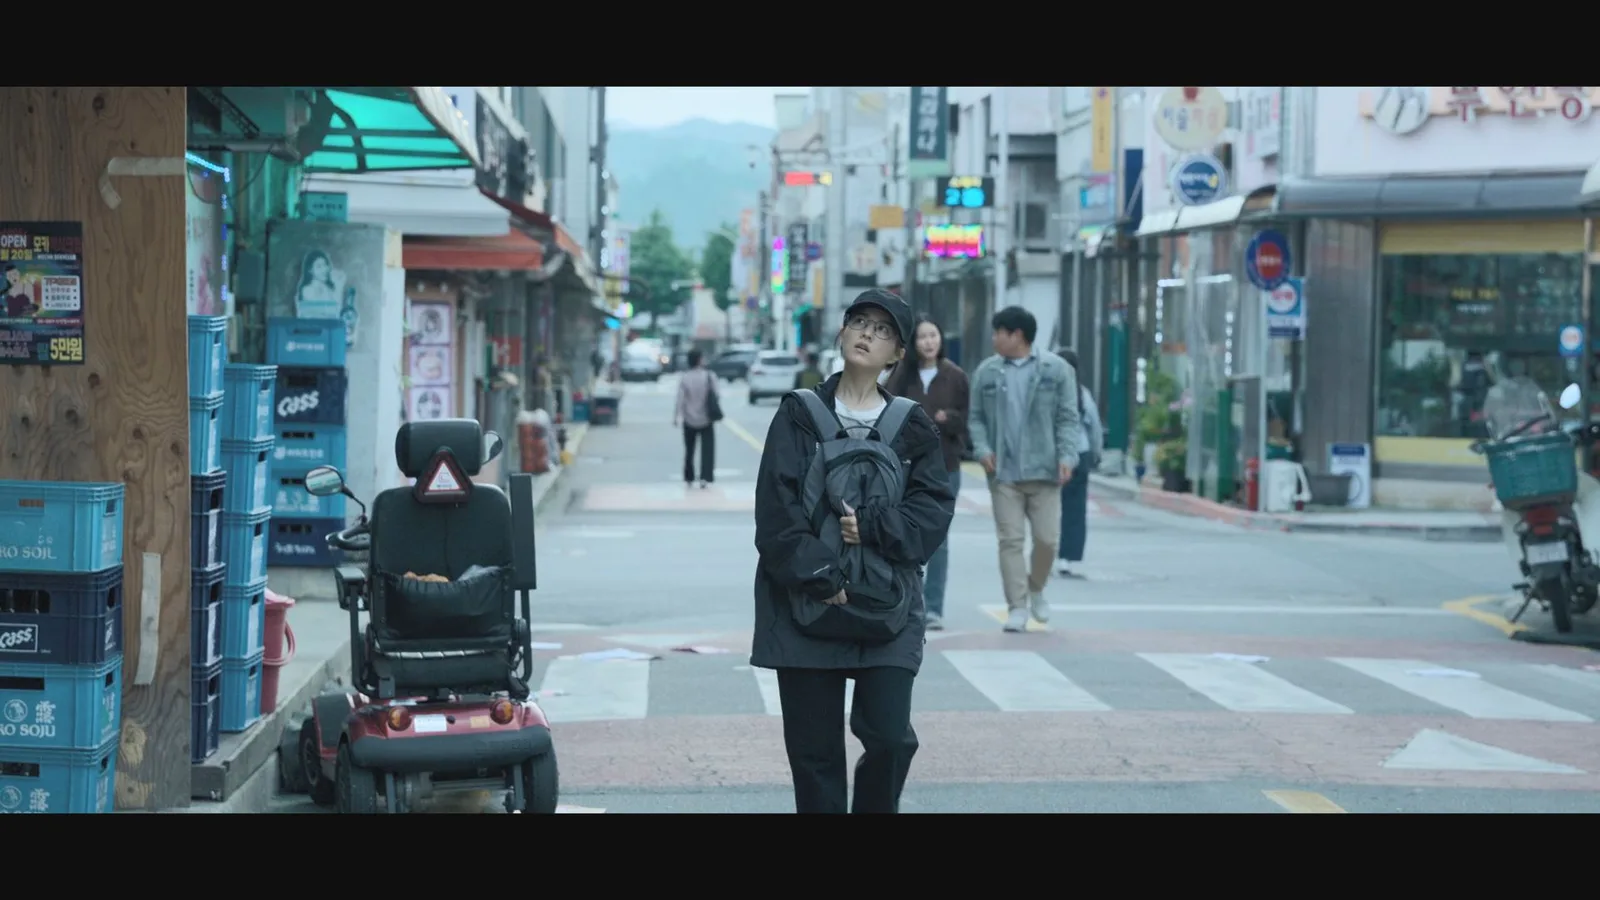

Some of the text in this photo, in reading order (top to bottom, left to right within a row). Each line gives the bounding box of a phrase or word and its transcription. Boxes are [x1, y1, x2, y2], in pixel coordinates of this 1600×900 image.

[0, 234, 27, 249] OPEN
[50, 336, 83, 361] 5만원
[19, 724, 56, 739] SOJU
